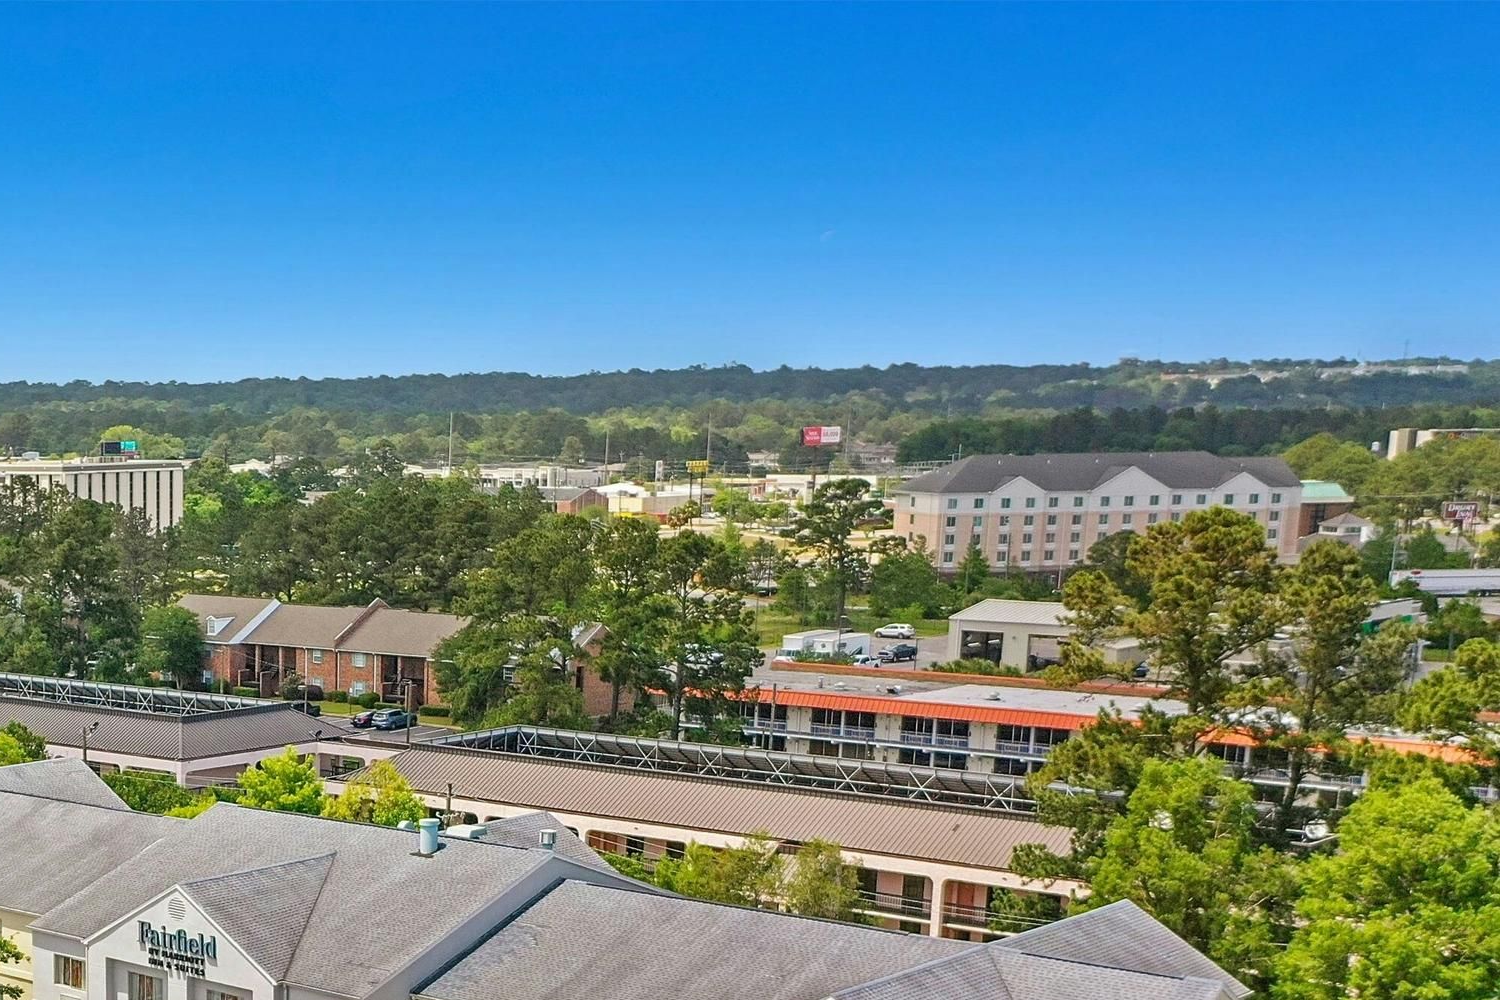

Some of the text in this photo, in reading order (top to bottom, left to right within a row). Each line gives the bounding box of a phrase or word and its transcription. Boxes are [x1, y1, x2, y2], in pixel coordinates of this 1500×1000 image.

[137, 920, 217, 960] Fairfield
[161, 949, 206, 966] MARRIOTT
[166, 961, 172, 969] &
[174, 963, 205, 977] SUITES
